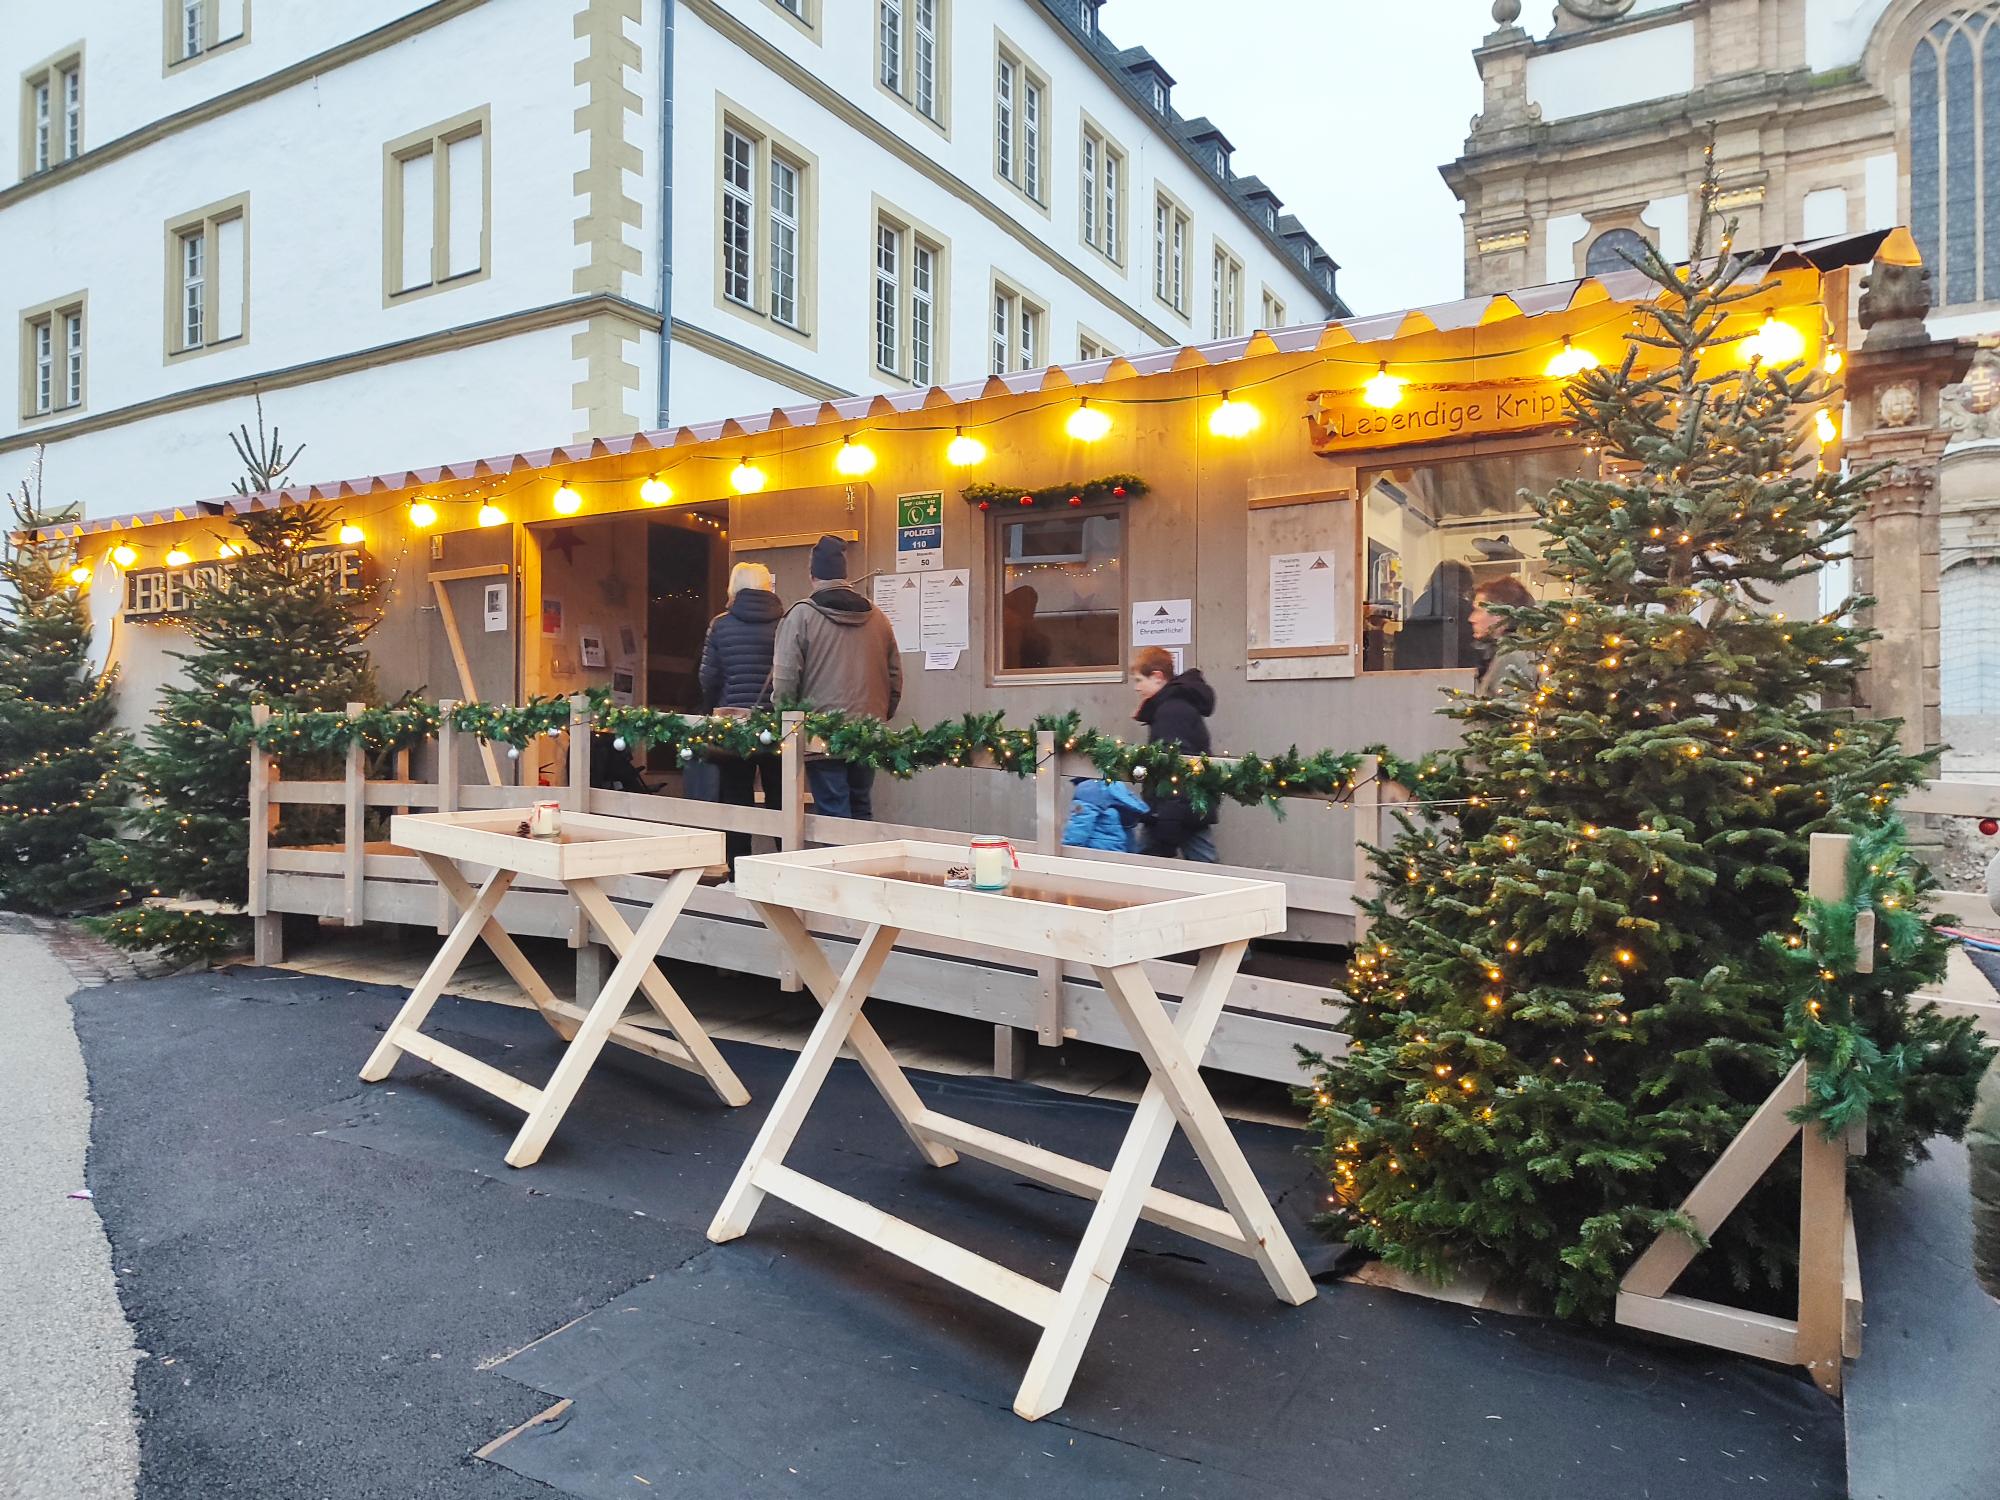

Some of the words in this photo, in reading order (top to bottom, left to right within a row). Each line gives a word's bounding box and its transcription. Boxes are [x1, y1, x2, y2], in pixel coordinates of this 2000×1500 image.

[1340, 401, 1484, 438] Lebendige
[904, 528, 935, 538] POLIZEI
[912, 540, 927, 549] 110
[920, 558, 930, 566] 50
